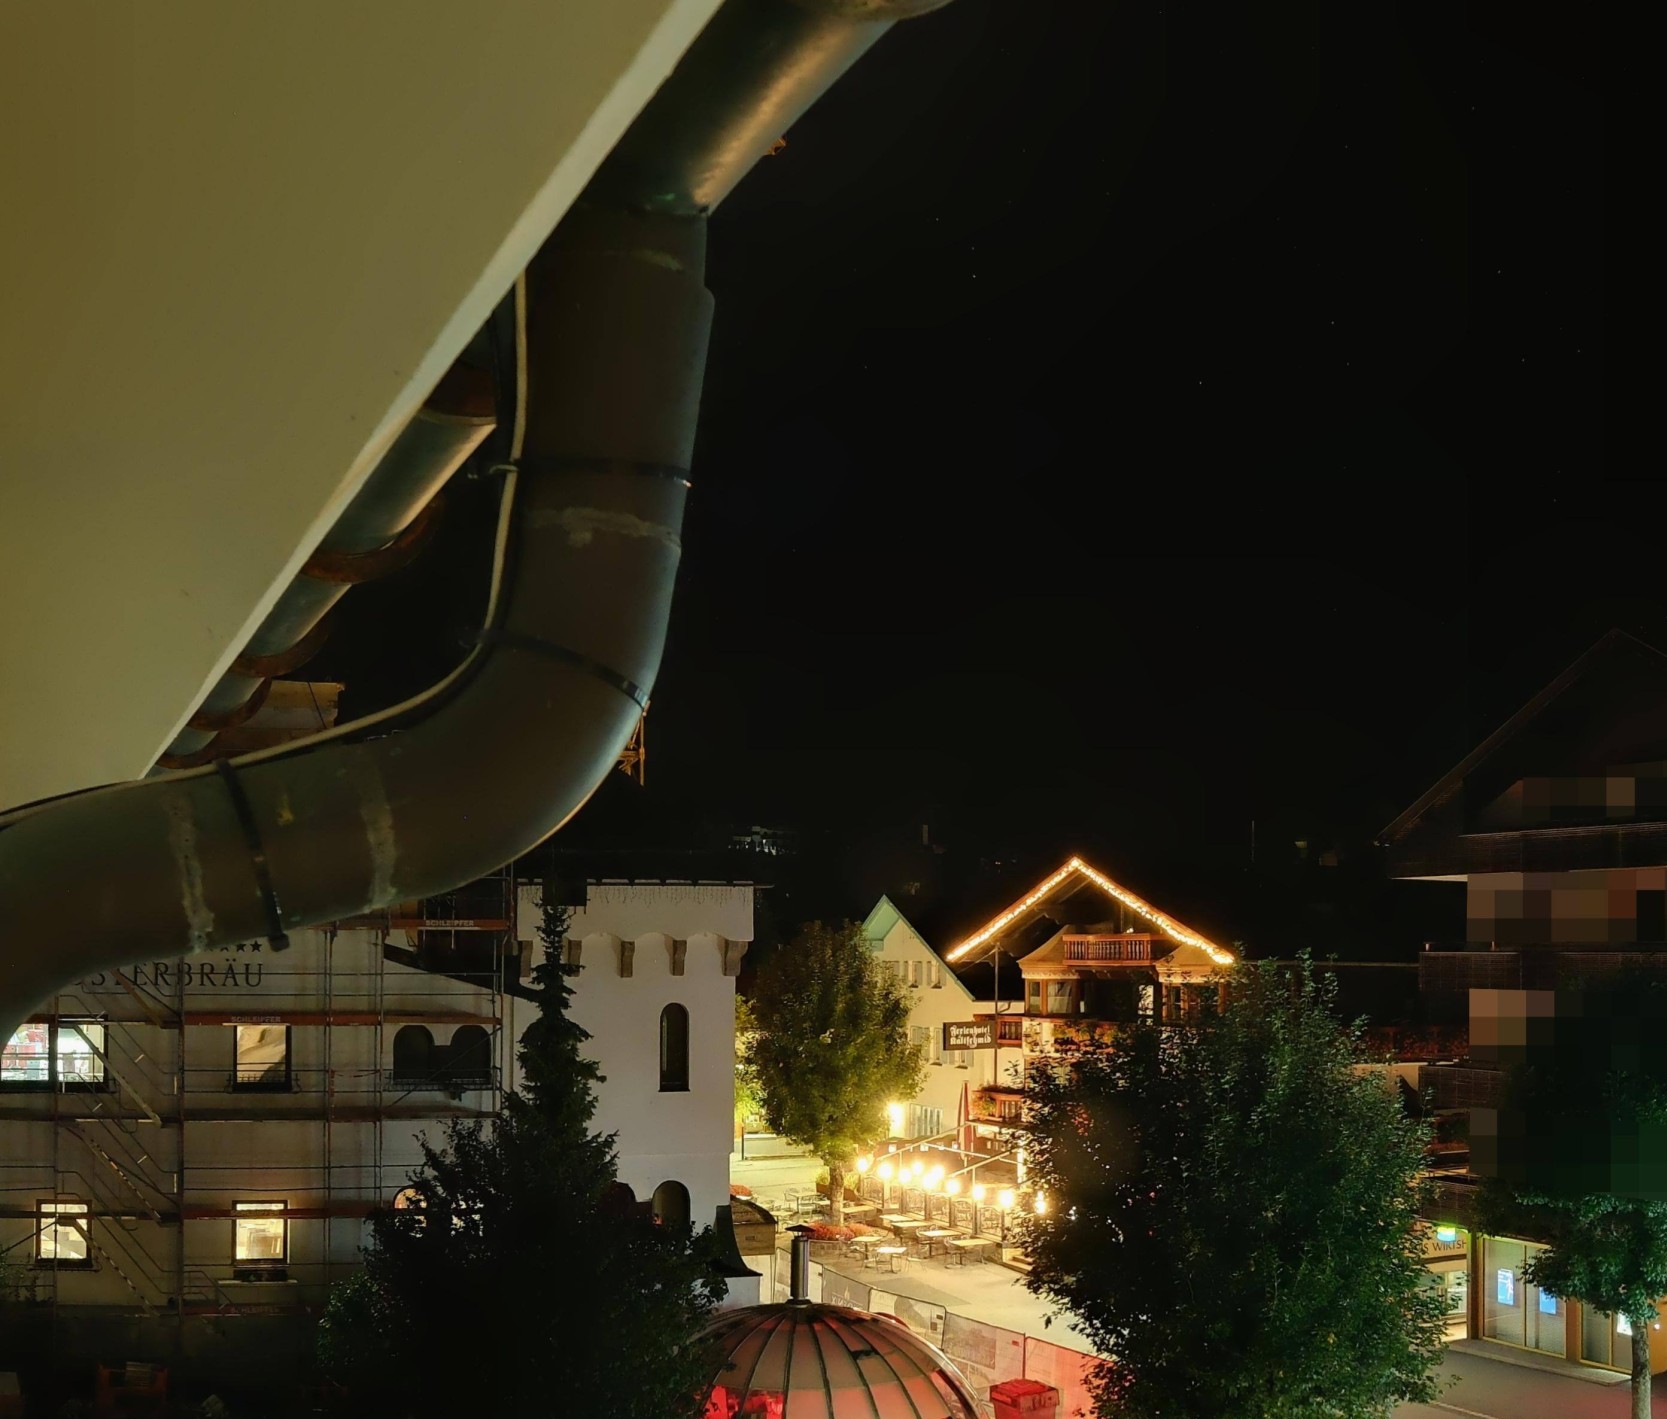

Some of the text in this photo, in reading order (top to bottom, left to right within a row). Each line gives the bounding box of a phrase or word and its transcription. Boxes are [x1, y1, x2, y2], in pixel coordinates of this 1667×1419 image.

[425, 919, 475, 928] SCHLEIPFER
[74, 958, 264, 988] STERBRÄU
[231, 1015, 282, 1024] SCHLEIPFER
